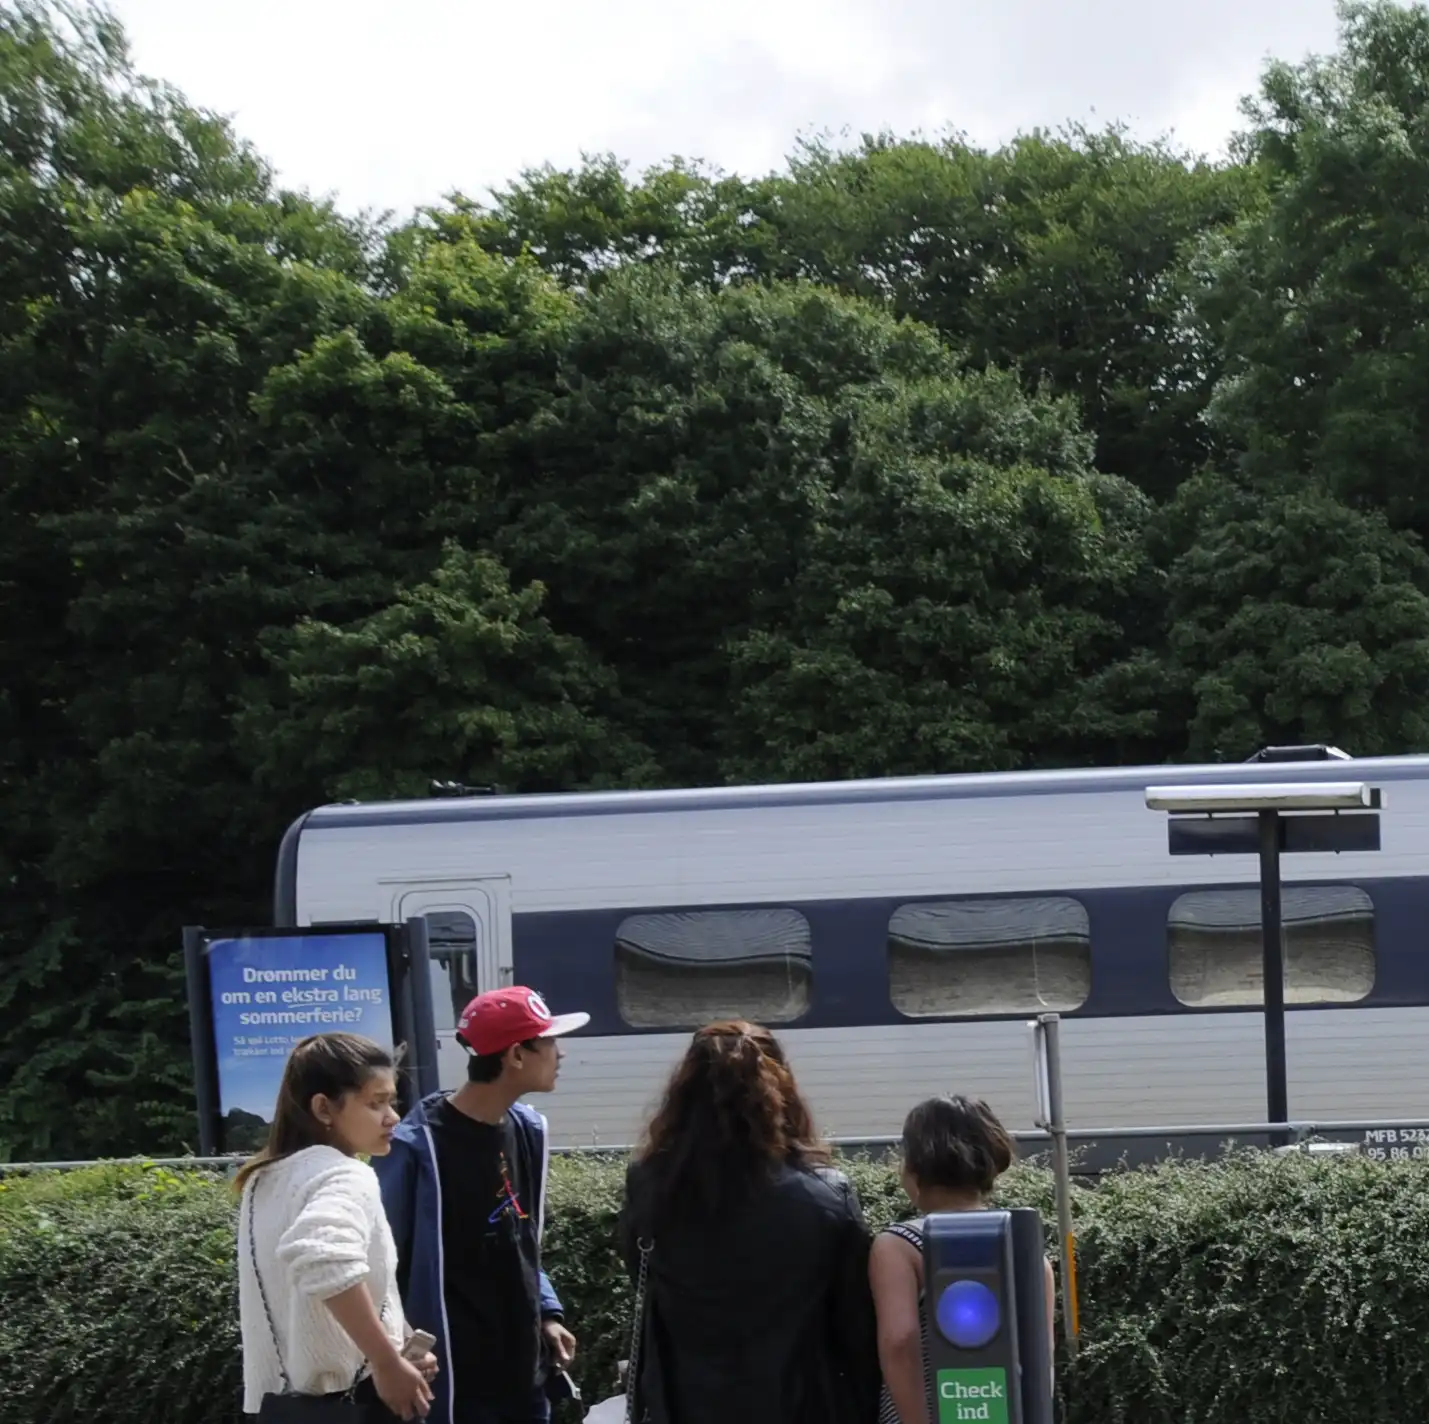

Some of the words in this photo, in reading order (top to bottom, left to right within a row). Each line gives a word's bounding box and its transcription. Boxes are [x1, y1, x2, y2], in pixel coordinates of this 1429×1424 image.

[243, 967, 329, 983] Drømmer
[333, 964, 356, 981] du
[221, 992, 250, 1004] om
[256, 990, 276, 1003] en
[282, 987, 338, 1002] ekstra
[344, 985, 382, 1005] lang
[240, 1007, 363, 1025] sommerferie?
[1365, 1129, 1397, 1143] MFB
[1368, 1147, 1386, 1160] 95
[940, 1381, 1003, 1399] Check
[956, 1403, 990, 1420] ind
